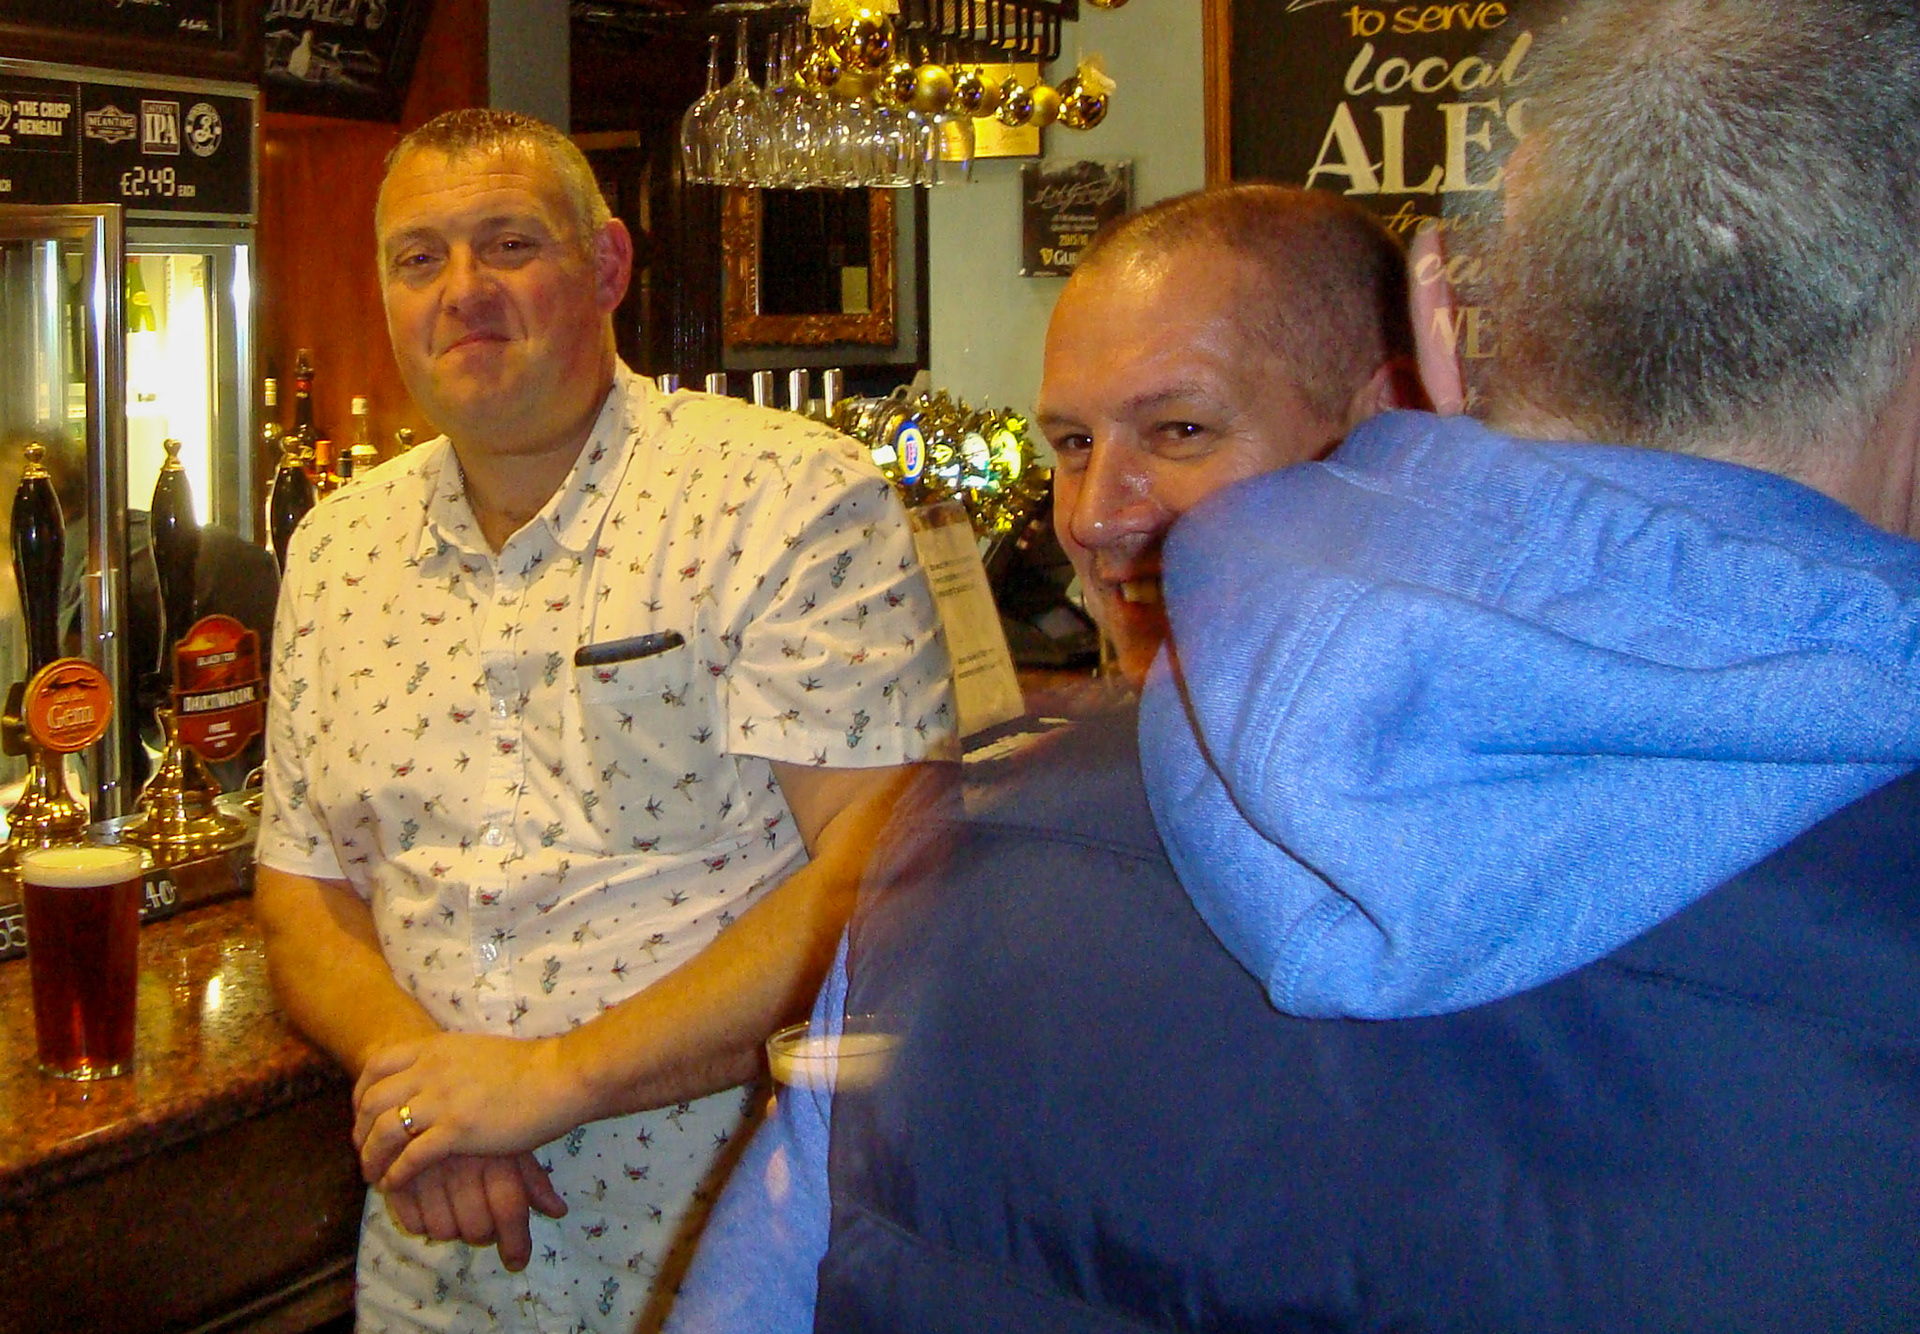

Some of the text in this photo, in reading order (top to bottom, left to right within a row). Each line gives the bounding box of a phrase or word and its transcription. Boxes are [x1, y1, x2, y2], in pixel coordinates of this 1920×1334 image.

[1344, 2, 1508, 36] to serve
[1344, 30, 1533, 96] local
[18, 100, 39, 117] THE
[40, 102, 71, 118] CRISP
[18, 118, 63, 136] BENGALI
[144, 113, 178, 144] IPA
